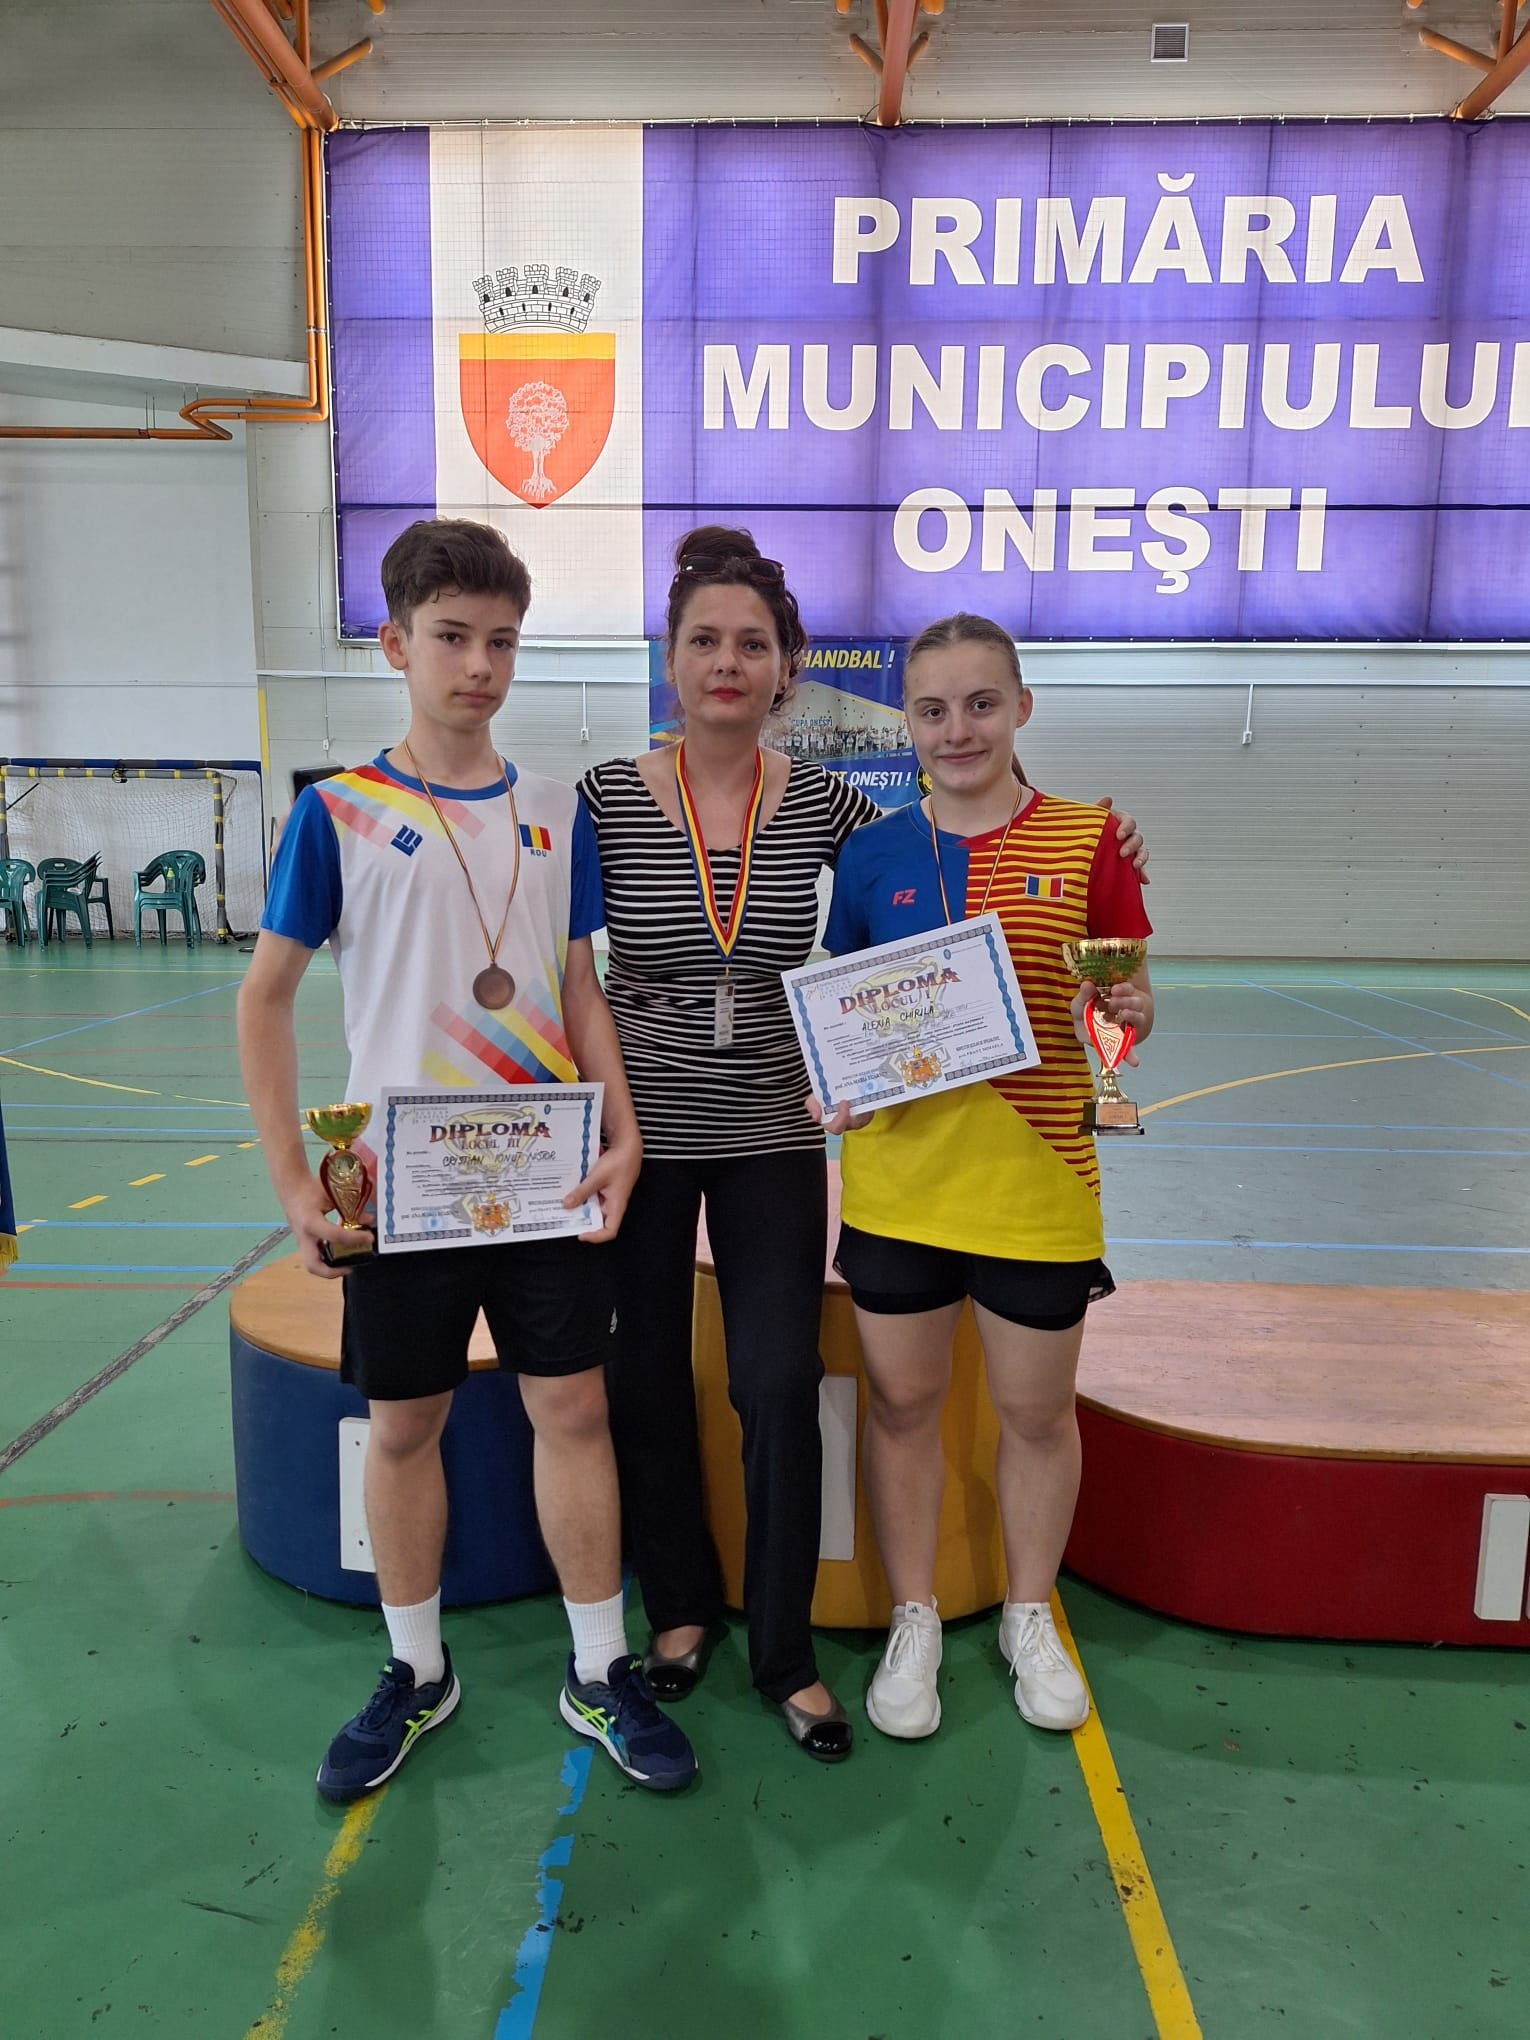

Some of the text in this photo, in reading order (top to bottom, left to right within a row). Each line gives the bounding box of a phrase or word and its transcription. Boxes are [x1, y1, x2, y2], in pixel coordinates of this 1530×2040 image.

[832, 173, 1424, 287] PRIMĂRIA
[801, 649, 883, 669] HANDBAL
[530, 848, 547, 857] ROU
[892, 889, 917, 905] FZ
[839, 967, 962, 1015] DIPLOMA
[872, 995, 919, 1014] LOCUL
[429, 1121, 551, 1143] DIPLOMA
